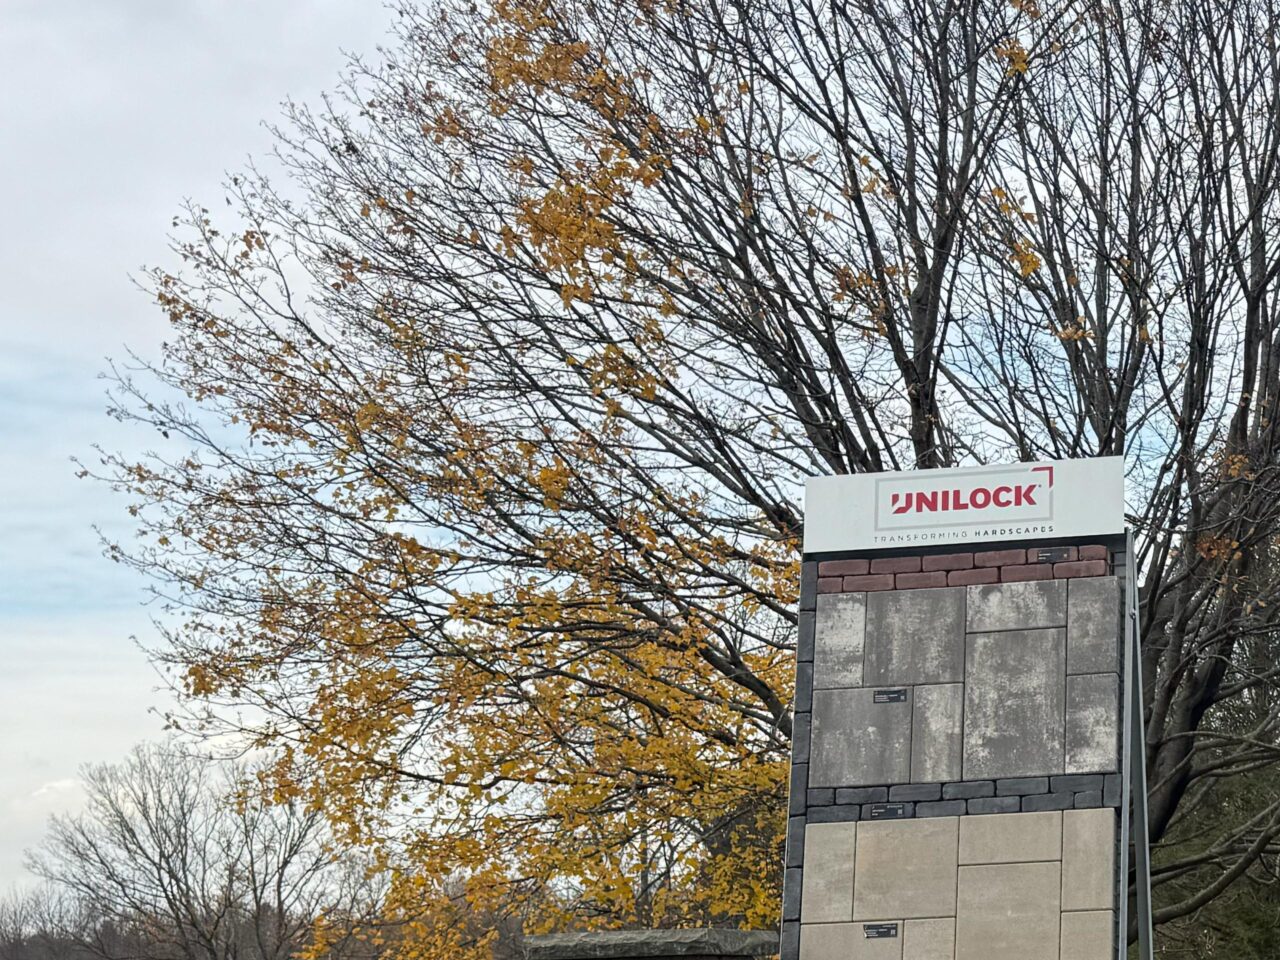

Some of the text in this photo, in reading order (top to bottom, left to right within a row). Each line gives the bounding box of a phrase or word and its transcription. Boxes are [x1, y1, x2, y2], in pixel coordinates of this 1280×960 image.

[891, 484, 1037, 515] UNILOCK
[874, 525, 1055, 544] TRANSFORMING HARDSCAPES
